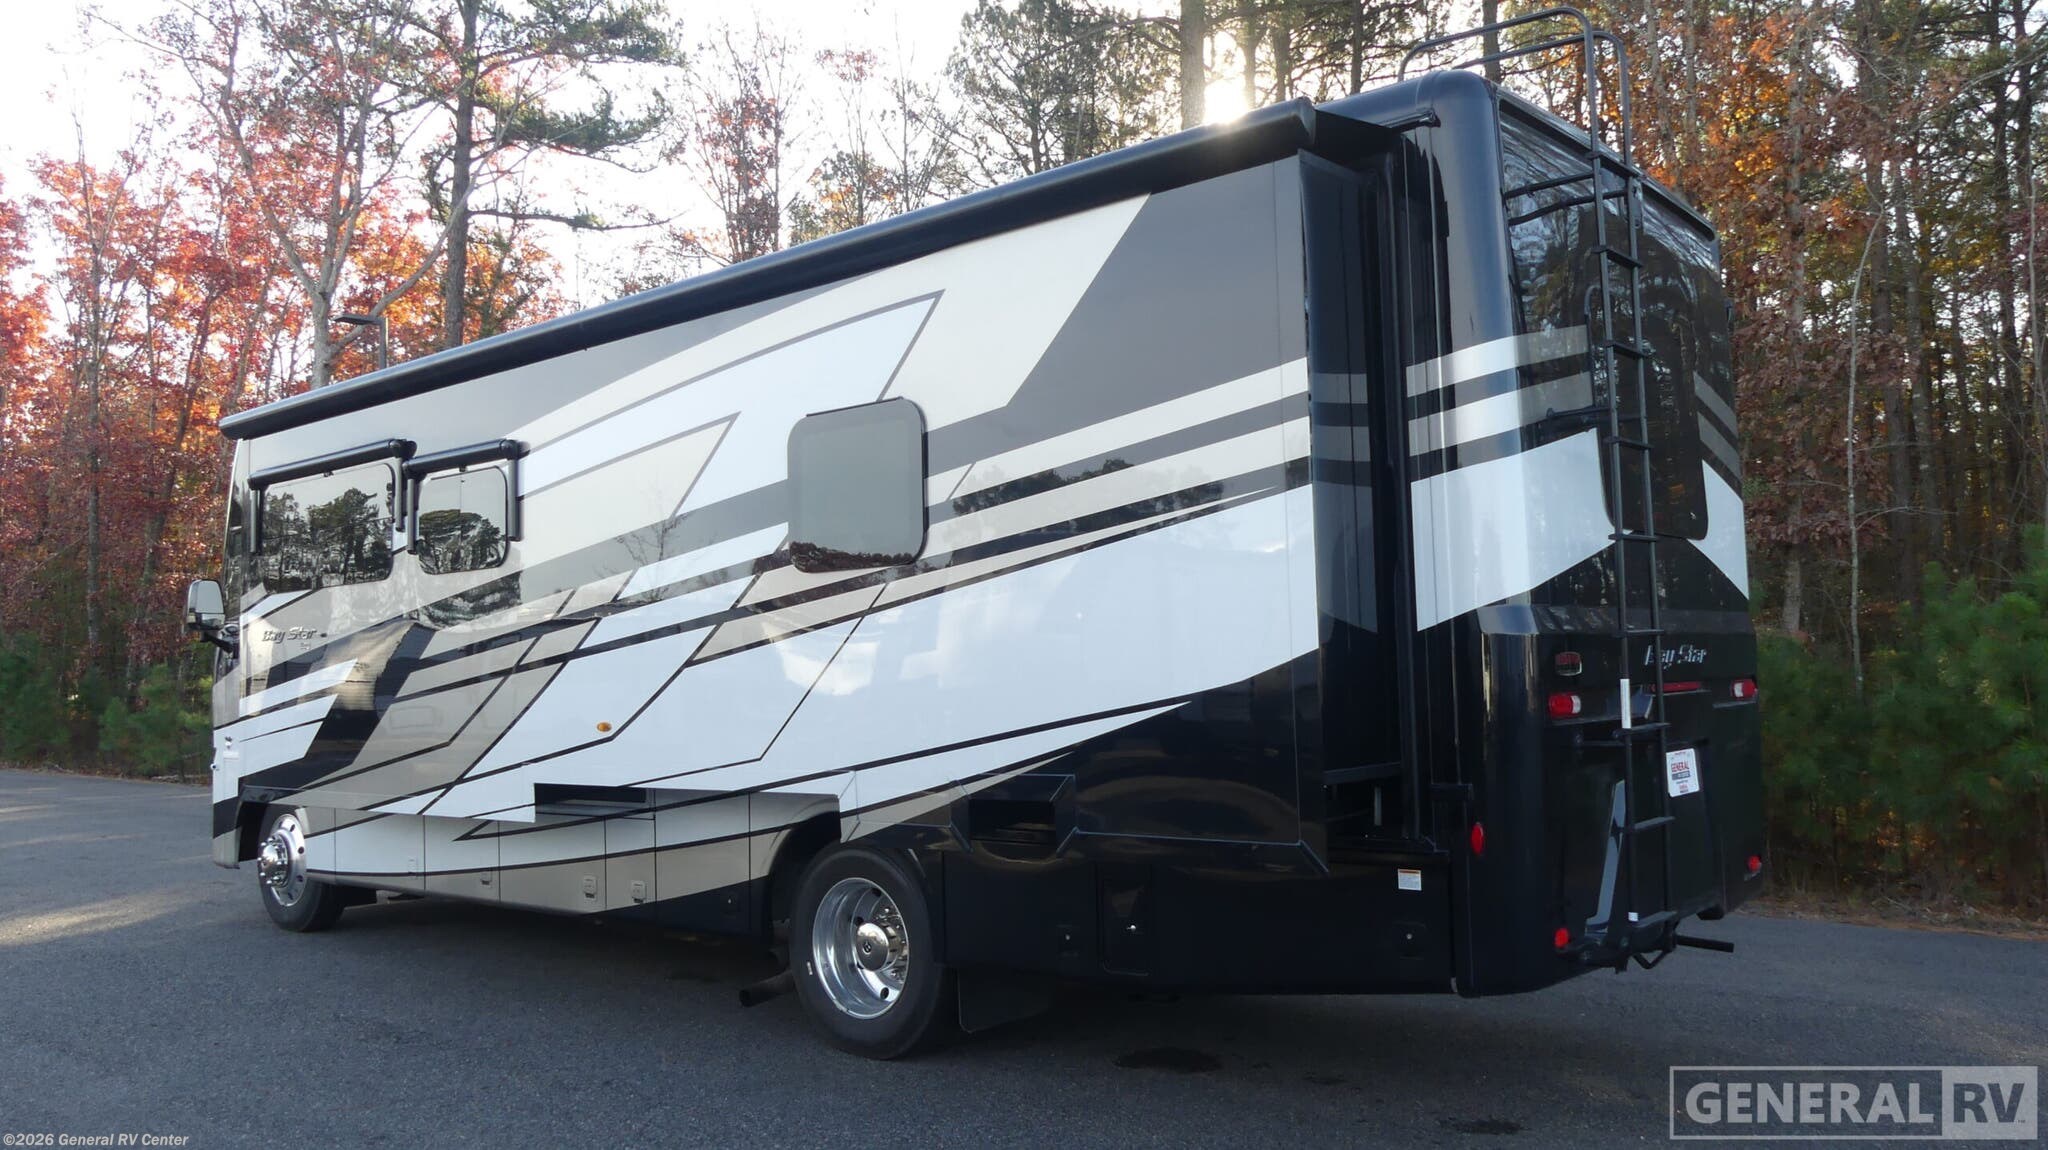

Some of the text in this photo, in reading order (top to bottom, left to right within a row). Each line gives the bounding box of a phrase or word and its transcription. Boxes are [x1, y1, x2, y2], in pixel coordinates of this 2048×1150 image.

[262, 626, 318, 644] Bay Star
[1677, 644, 1707, 664] Star
